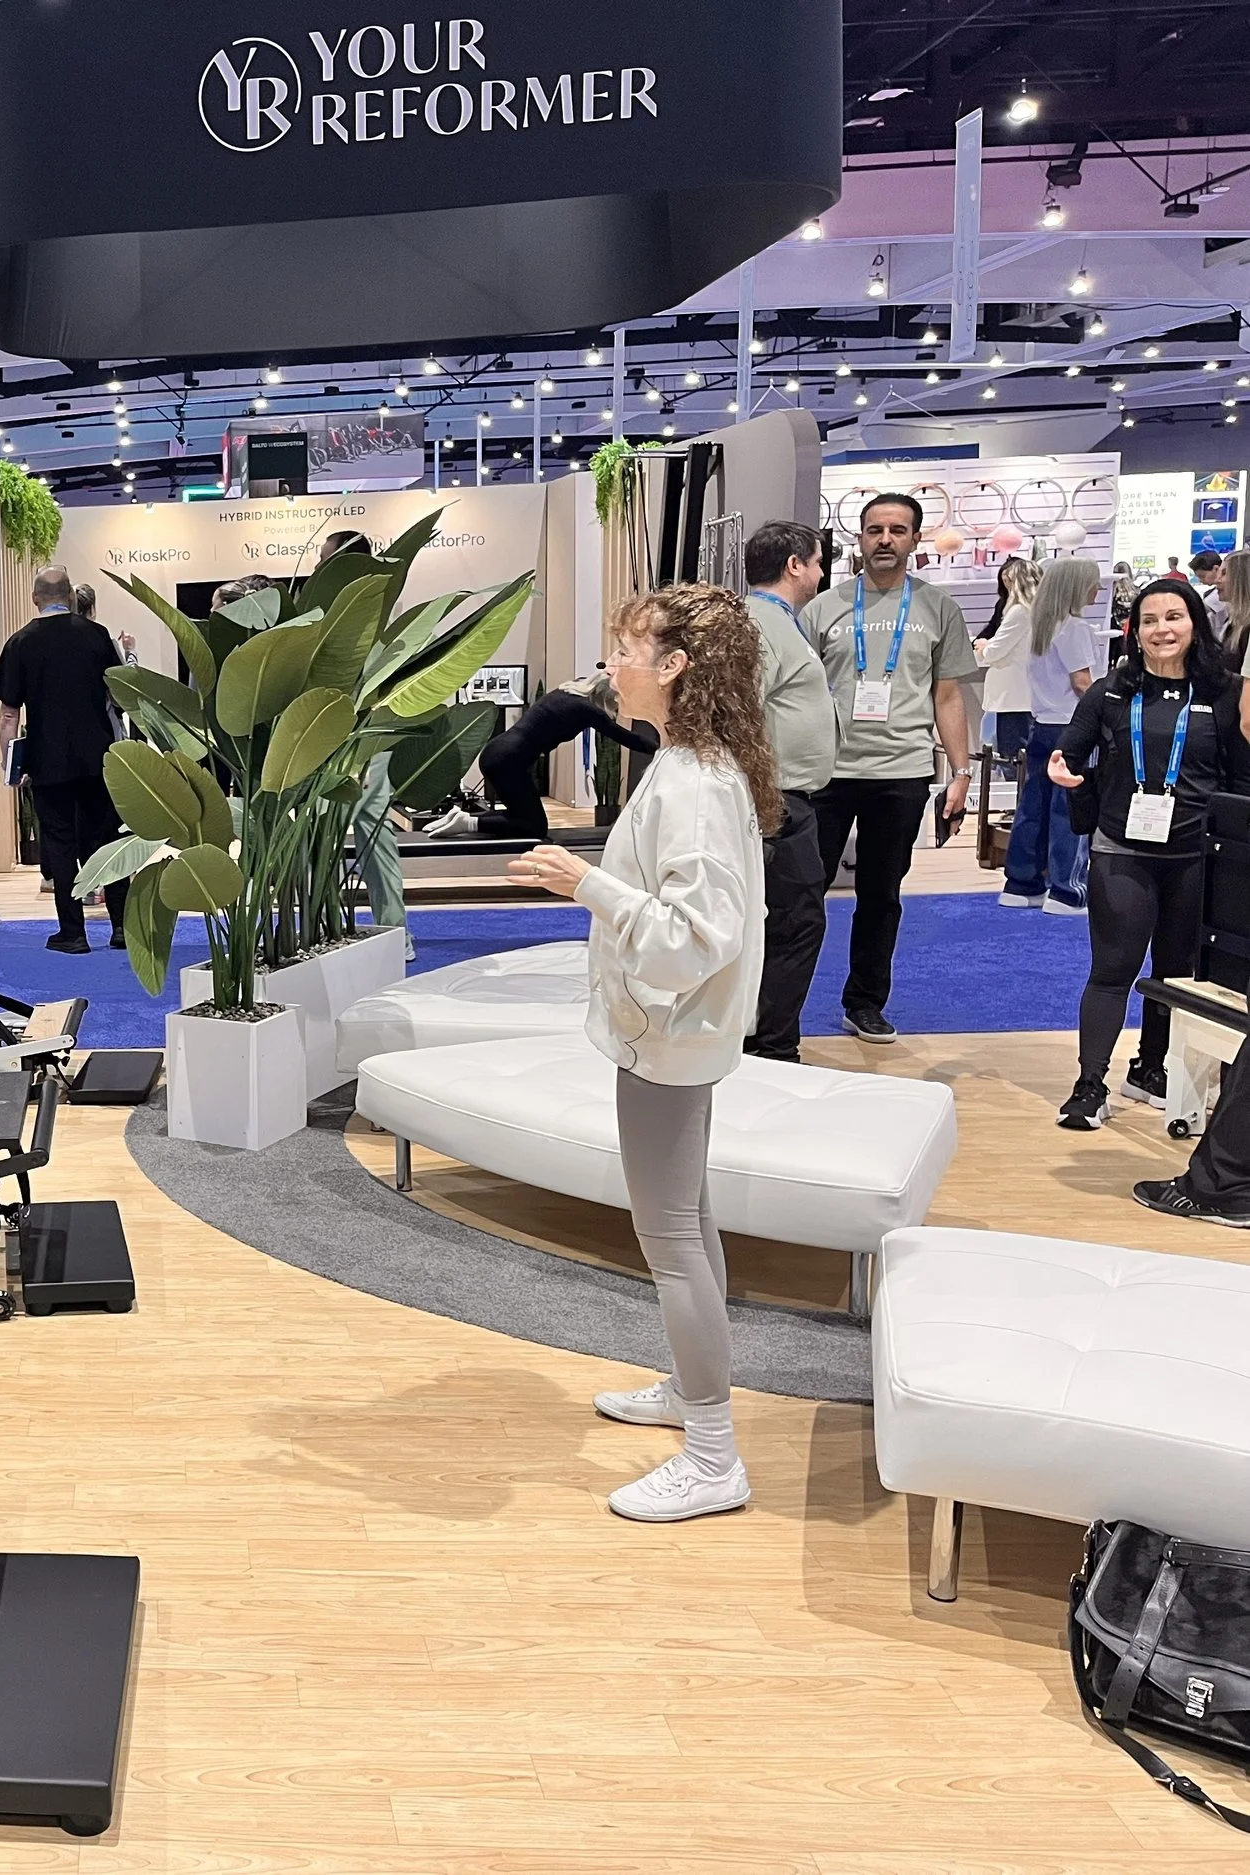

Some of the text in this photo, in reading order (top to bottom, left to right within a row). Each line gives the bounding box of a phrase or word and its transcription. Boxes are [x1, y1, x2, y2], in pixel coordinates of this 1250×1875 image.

[308, 18, 486, 83] YOUR
[312, 66, 658, 146] REFORMER
[1122, 492, 1143, 500] ORE
[219, 505, 366, 523] HYBRID INSTRUCTOR LED
[1140, 508, 1166, 516] JUST
[263, 525, 306, 535] Powered
[389, 533, 486, 549] IuctorPro
[128, 549, 191, 563] KioskPro
[266, 542, 321, 556] ClassPr
[845, 619, 925, 634] merritew
